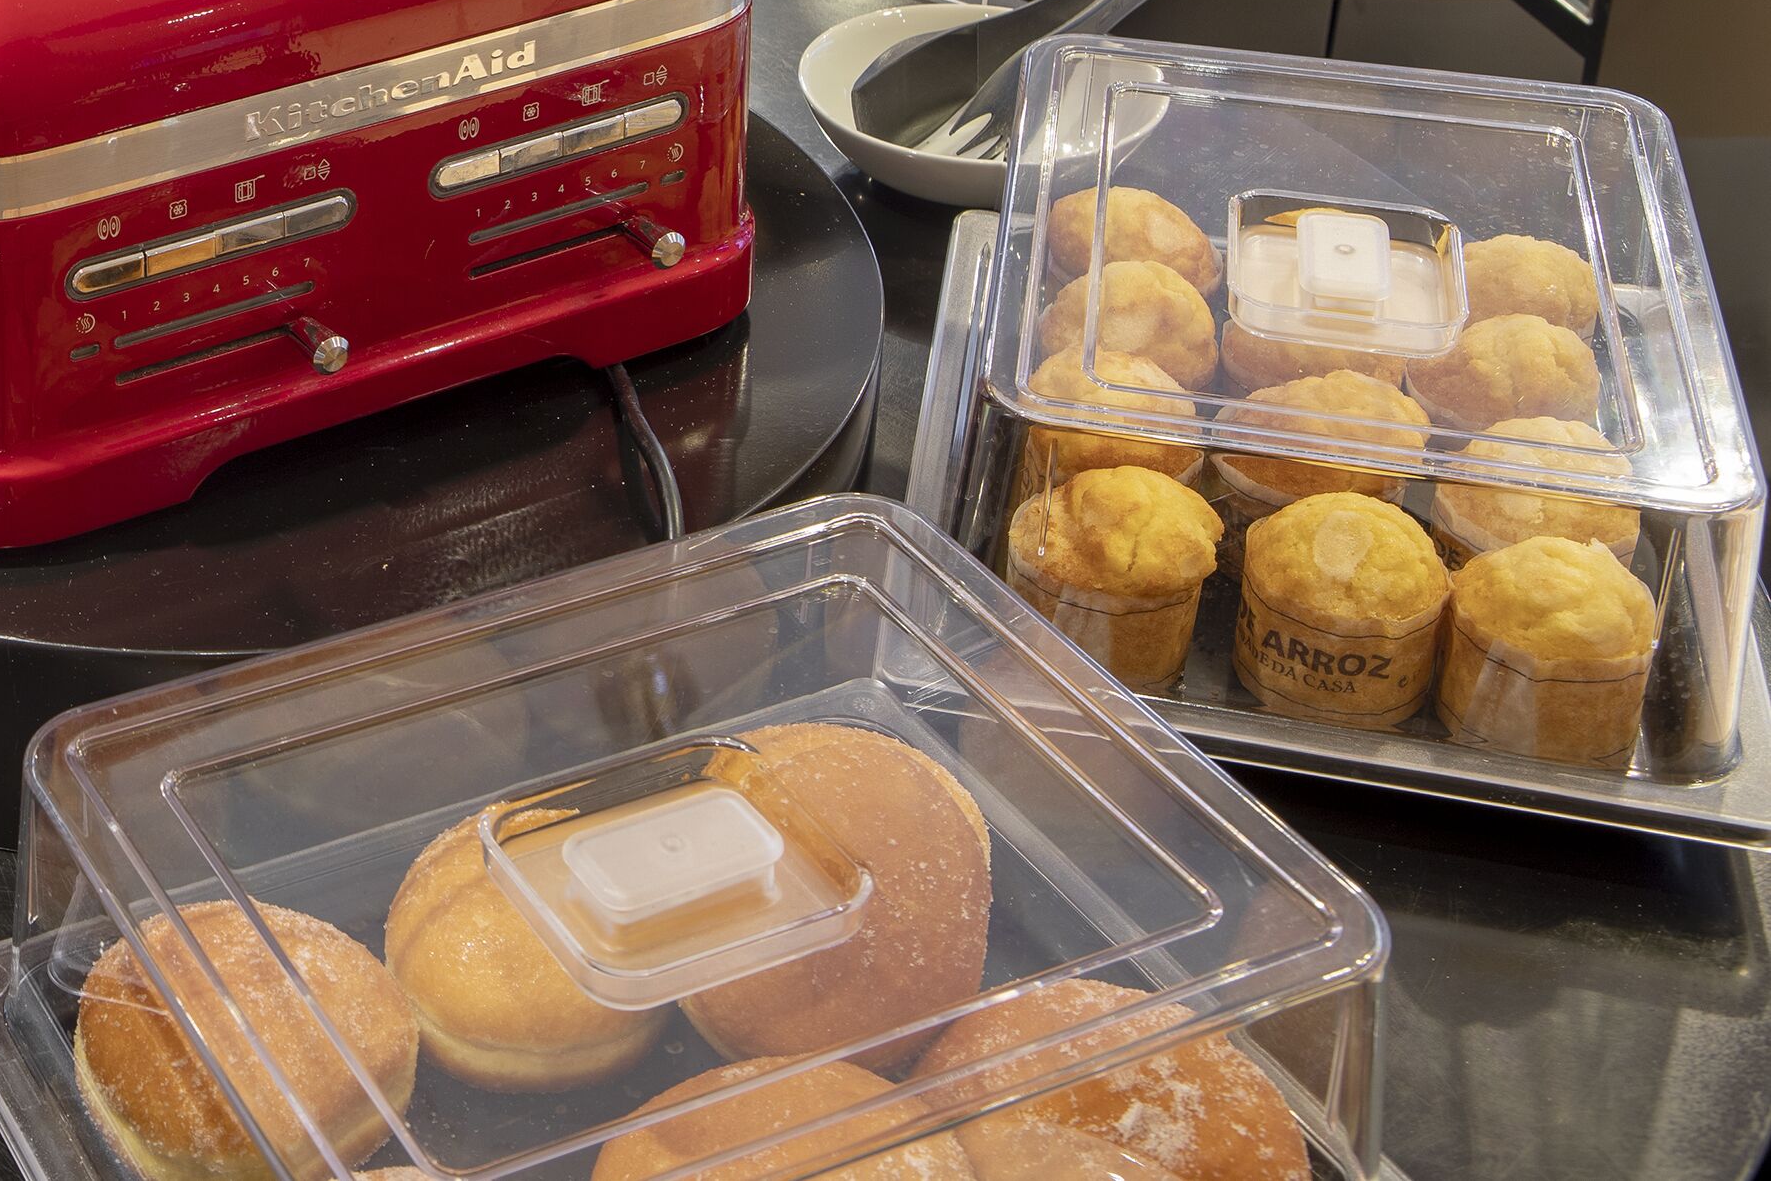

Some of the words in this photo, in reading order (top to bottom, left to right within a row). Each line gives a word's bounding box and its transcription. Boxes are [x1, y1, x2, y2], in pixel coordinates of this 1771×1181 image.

[245, 40, 536, 142] KitchenAid
[476, 208, 481, 217] 1
[505, 200, 511, 209] 2
[531, 192, 538, 202] 3
[558, 184, 565, 193] 4
[585, 176, 591, 186] 5
[611, 169, 618, 178] 6
[639, 160, 646, 169] 7
[122, 310, 127, 320] 1
[153, 301, 160, 311] 2
[183, 292, 190, 302] 3
[213, 284, 220, 293] 4
[243, 275, 250, 285] 5
[272, 267, 279, 277] 6
[303, 258, 310, 267] 7
[1261, 629, 1392, 680] ARROZ
[1271, 660, 1297, 681] DA
[1303, 673, 1357, 694] CASA
